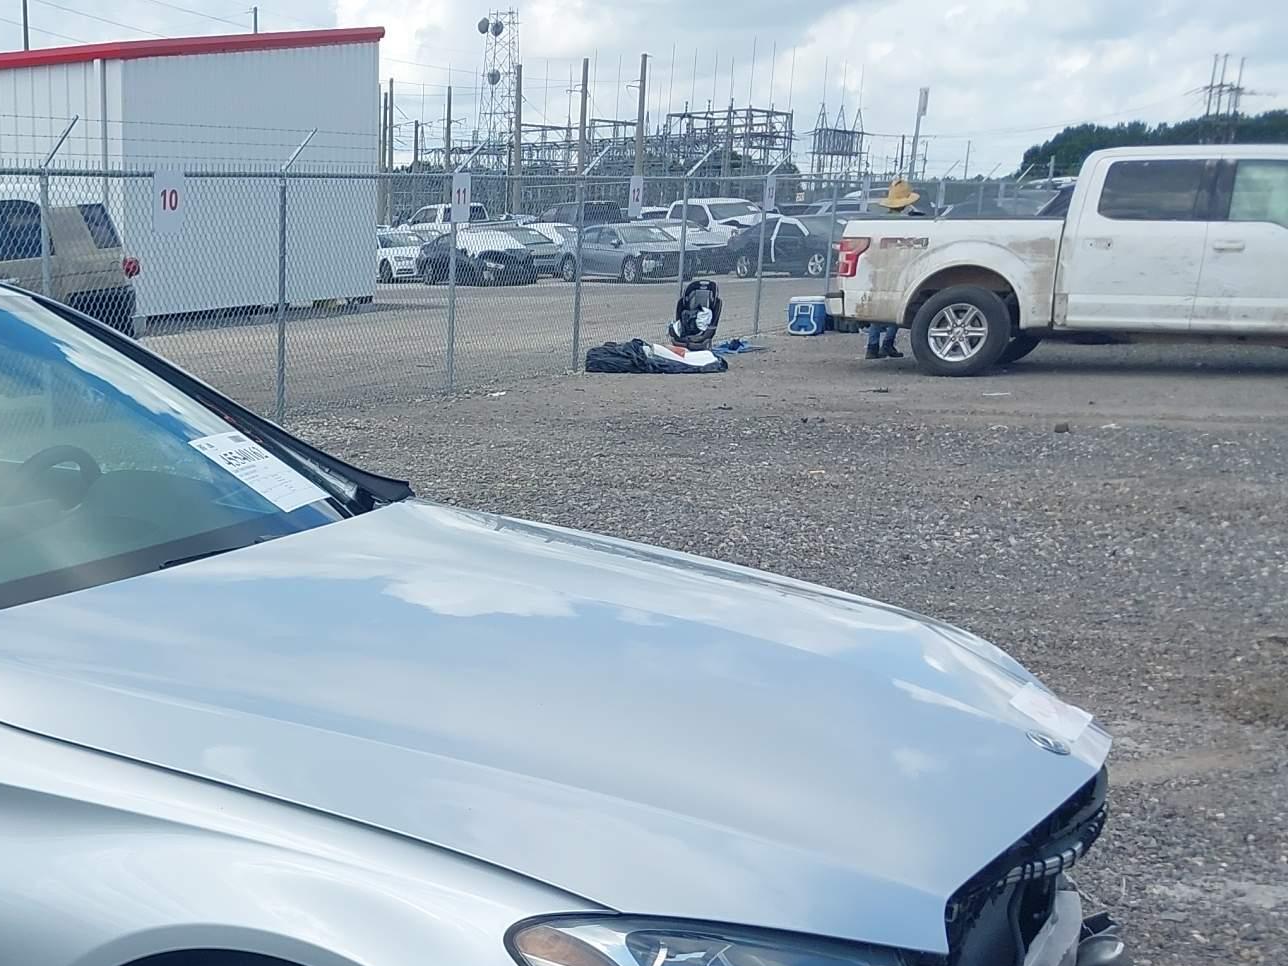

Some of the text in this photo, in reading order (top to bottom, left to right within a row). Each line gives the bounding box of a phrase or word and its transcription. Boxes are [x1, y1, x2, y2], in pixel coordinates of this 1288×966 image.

[160, 188, 179, 211] 10
[456, 187, 467, 205] 11
[632, 187, 641, 203] 12
